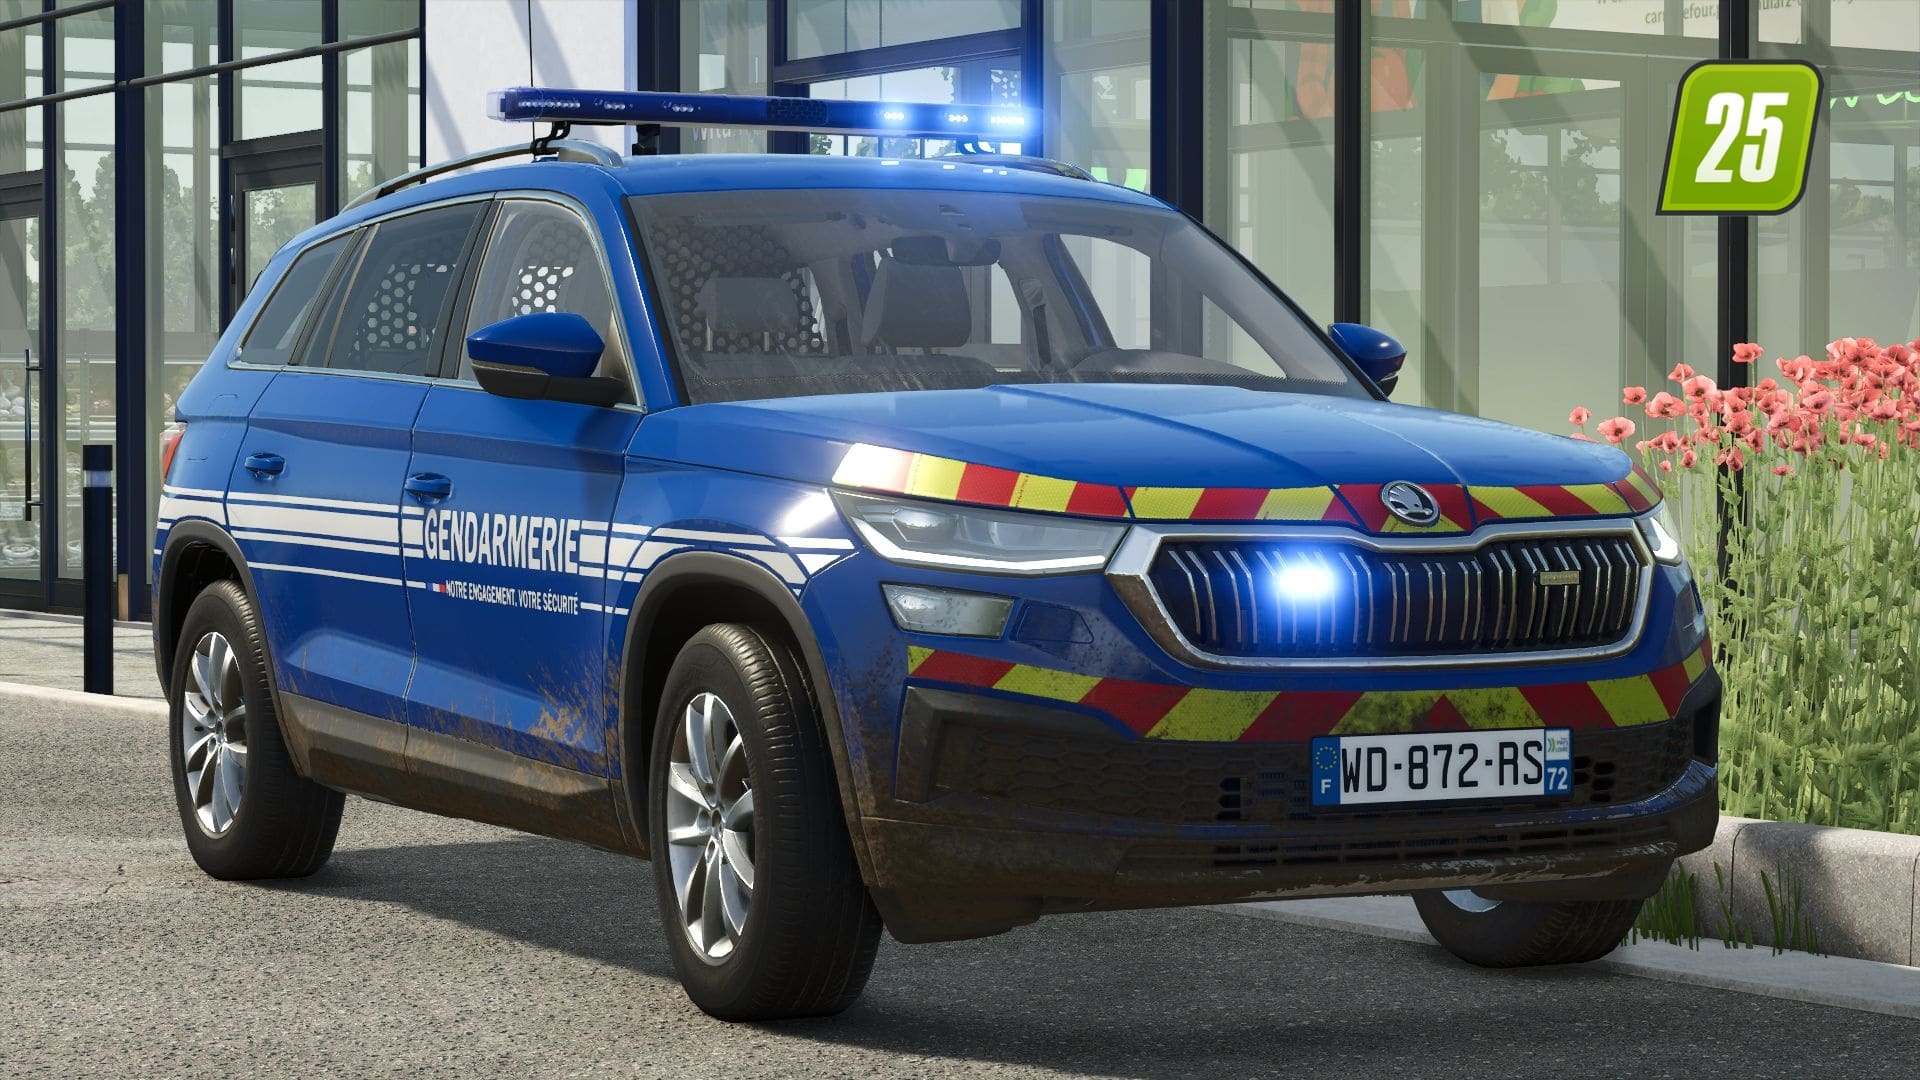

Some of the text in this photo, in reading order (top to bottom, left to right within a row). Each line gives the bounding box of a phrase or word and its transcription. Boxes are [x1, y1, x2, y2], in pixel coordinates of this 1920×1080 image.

[424, 508, 581, 574] GENDARMERIE
[445, 579, 579, 616] NOTRE ENGAGEMENT. VOTRE SÉCURITÉ
[1341, 740, 1543, 793] WD-872-RS
[1547, 767, 1569, 791] 72
[1320, 779, 1332, 794] F
